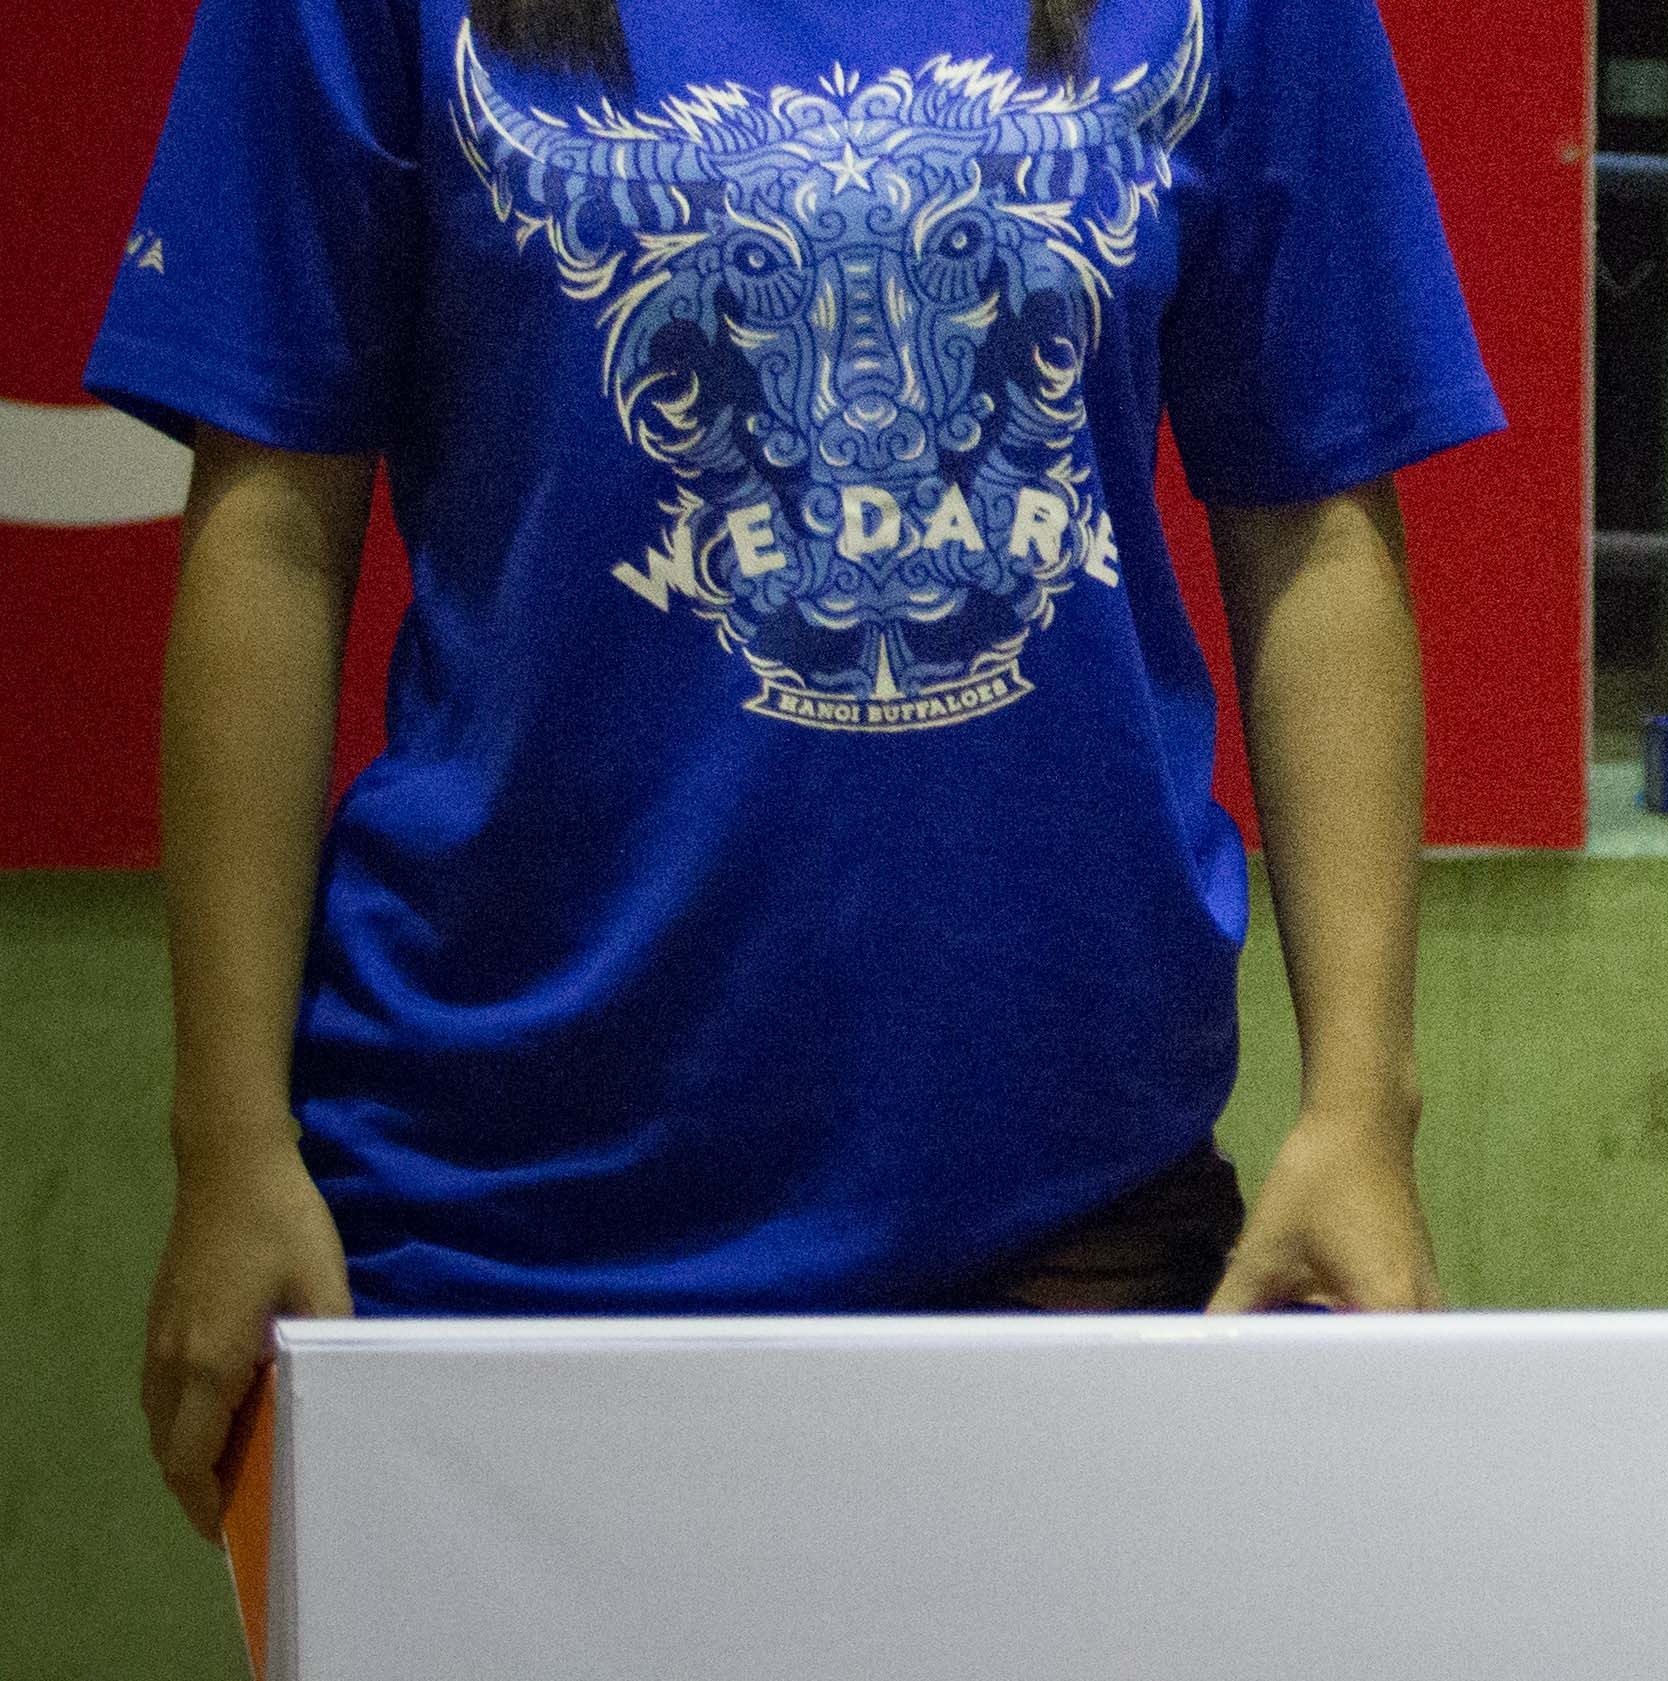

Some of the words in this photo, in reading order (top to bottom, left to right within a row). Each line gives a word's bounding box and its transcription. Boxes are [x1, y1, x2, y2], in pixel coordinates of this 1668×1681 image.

[611, 501, 788, 613] WE
[839, 483, 1120, 589] DARE
[778, 690, 861, 722] HANOI
[867, 680, 1008, 722] BUFFALOES
